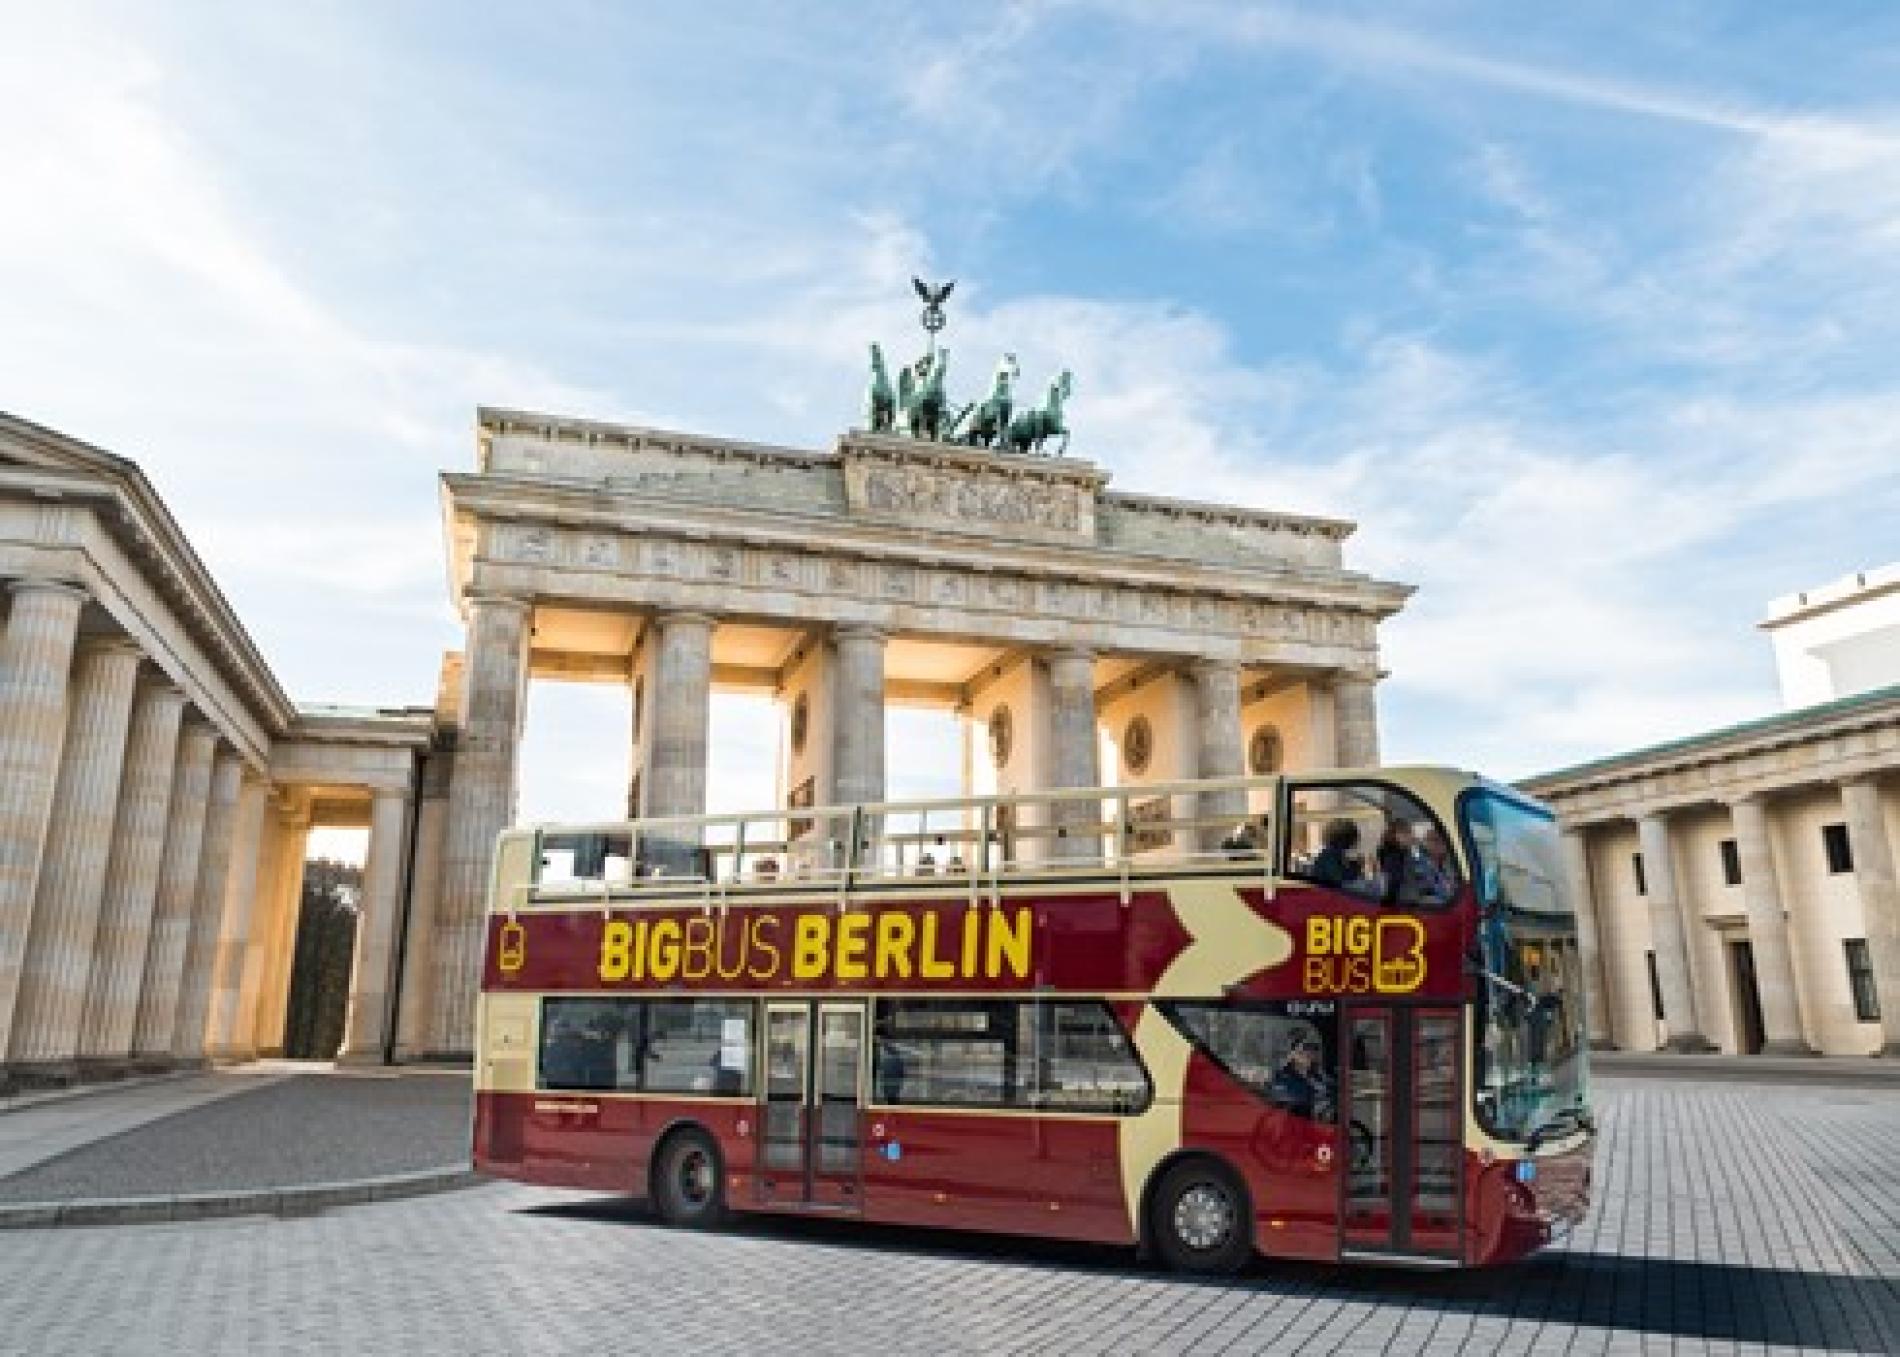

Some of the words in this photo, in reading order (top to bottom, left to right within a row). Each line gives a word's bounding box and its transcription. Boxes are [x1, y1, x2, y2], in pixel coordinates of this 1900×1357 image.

[792, 907, 1033, 980] BERLIN
[1305, 915, 1371, 954] BIG
[1303, 956, 1371, 994] BUS
